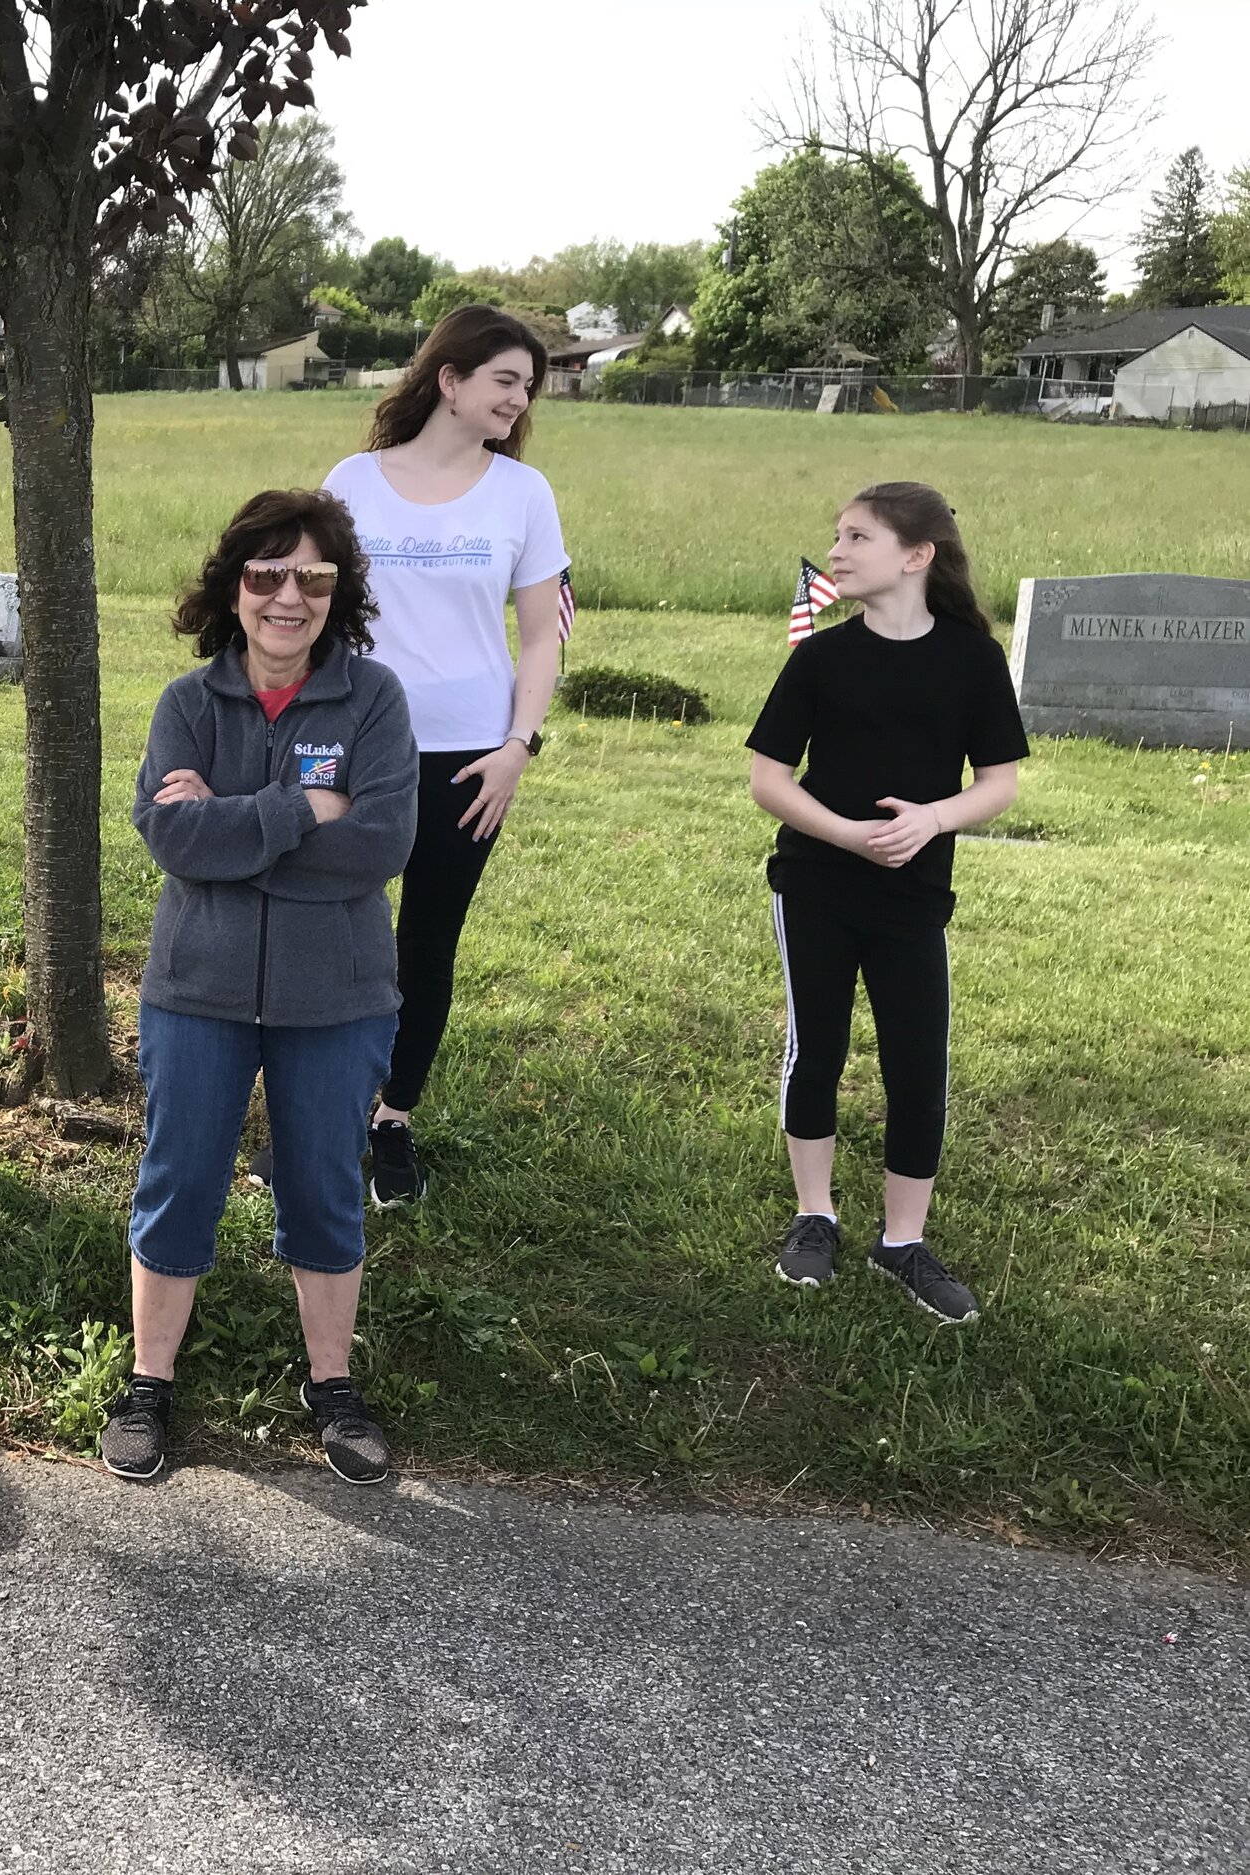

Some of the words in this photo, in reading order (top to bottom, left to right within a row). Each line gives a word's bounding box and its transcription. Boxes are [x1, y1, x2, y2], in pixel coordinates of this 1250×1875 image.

[397, 536, 443, 554] Delta
[447, 535, 492, 551] Delta
[374, 557, 419, 568] PRIMARY
[422, 557, 493, 568] RECRUITMENT
[1070, 617, 1146, 638] MLYNEK
[1163, 619, 1246, 640] KRATZER
[300, 772, 317, 780] 100
[318, 772, 335, 781] TOP
[299, 779, 335, 787] HOSPITALS
